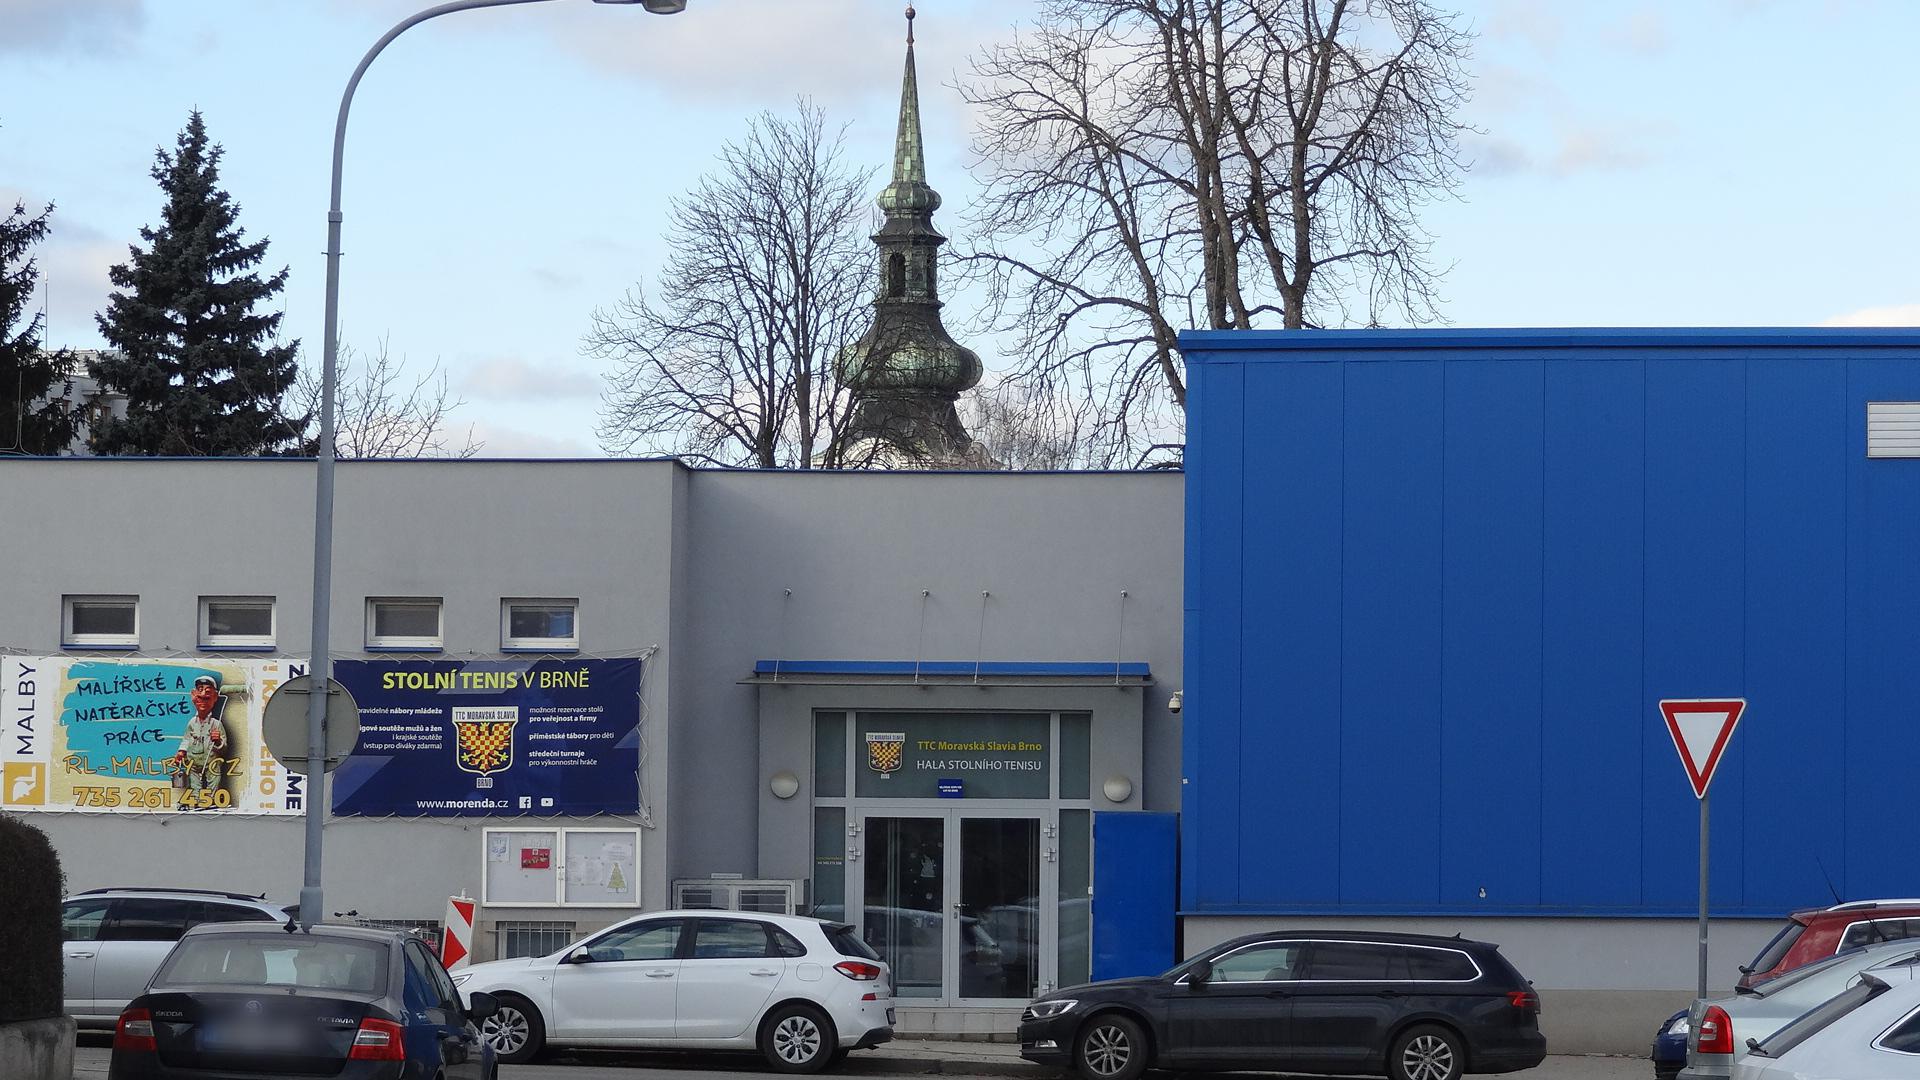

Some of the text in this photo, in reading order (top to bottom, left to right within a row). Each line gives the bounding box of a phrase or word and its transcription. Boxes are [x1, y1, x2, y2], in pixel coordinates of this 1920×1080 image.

[77, 672, 186, 697] MALÍŘSKÉ A
[383, 667, 590, 690] STOLNÍ TENIS V BRNĚ
[16, 662, 36, 755] MALBY
[75, 697, 191, 723] NATĚRAČSKÉ
[390, 707, 413, 715] nábory
[104, 725, 165, 746] PRÁCE
[918, 741, 936, 750] TTC
[987, 740, 1016, 750] Slavia
[1019, 741, 1042, 751] Brno
[63, 754, 243, 777] RL-MALBYCZ
[917, 758, 1042, 771] HALA STOLNÍHO TENISU
[73, 786, 231, 809] 735 261 450
[417, 799, 509, 808] www.morenda.cz
